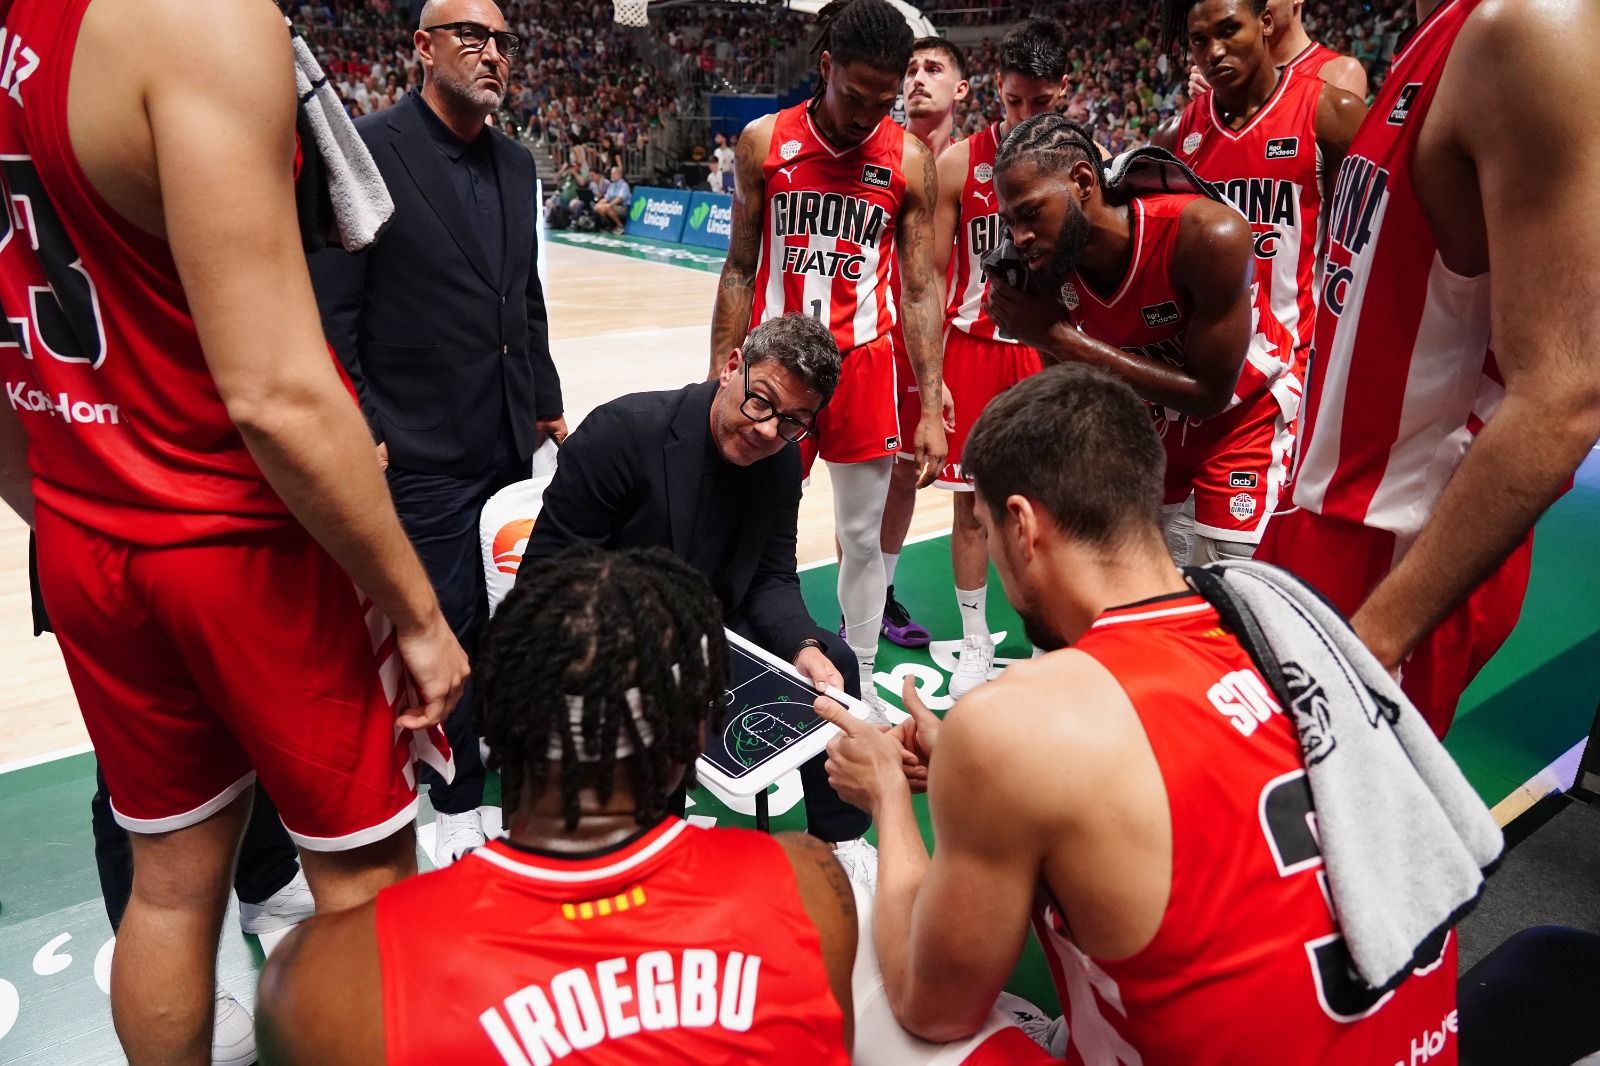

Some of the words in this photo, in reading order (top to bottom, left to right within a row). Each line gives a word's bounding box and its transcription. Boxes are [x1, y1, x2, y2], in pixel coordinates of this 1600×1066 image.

[864, 176, 889, 187] endesa
[865, 169, 878, 180] liga
[771, 191, 887, 249] GIRONA
[781, 247, 867, 281] FIATC
[1232, 478, 1252, 486] acb
[479, 949, 762, 1066] IROEGBU
